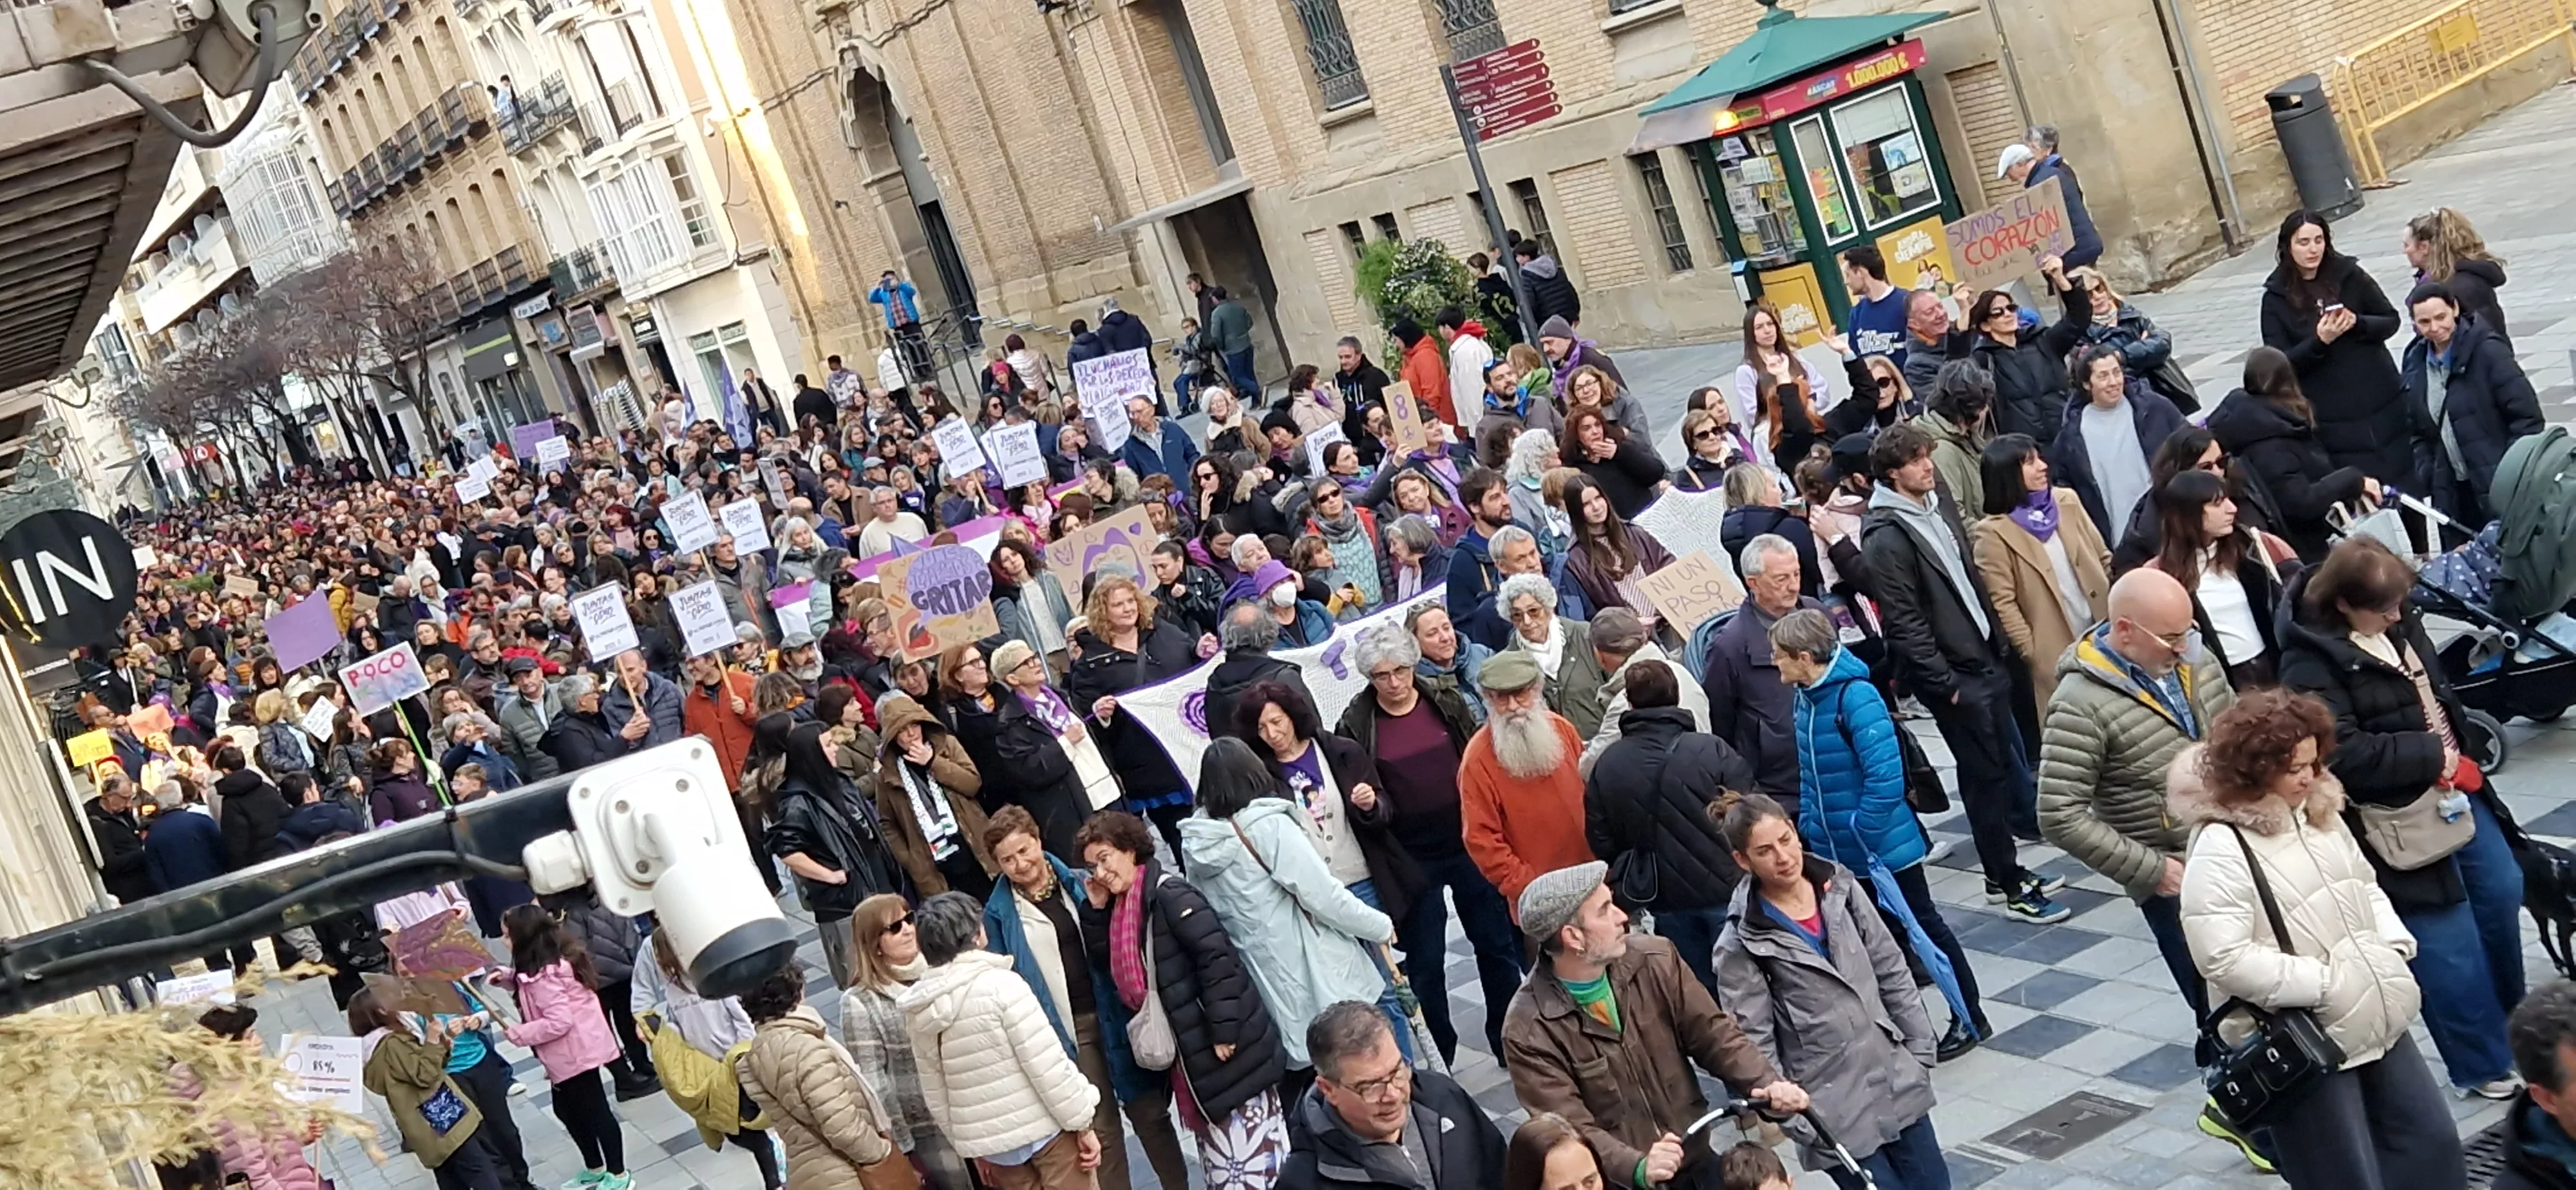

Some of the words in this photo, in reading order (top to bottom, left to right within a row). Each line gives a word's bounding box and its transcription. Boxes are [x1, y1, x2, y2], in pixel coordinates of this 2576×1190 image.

[1947, 207, 2005, 247] SOMOS
[2014, 196, 2038, 220] EL
[1965, 205, 2060, 266] CORAZÓN
[12, 535, 114, 624] IN
[911, 570, 991, 615] GRITAR
[1650, 576, 1675, 596] NI
[1676, 557, 1707, 580] UN
[581, 592, 614, 616] JUNTAS
[1665, 580, 1720, 618] PASO
[348, 652, 405, 687] POCO
